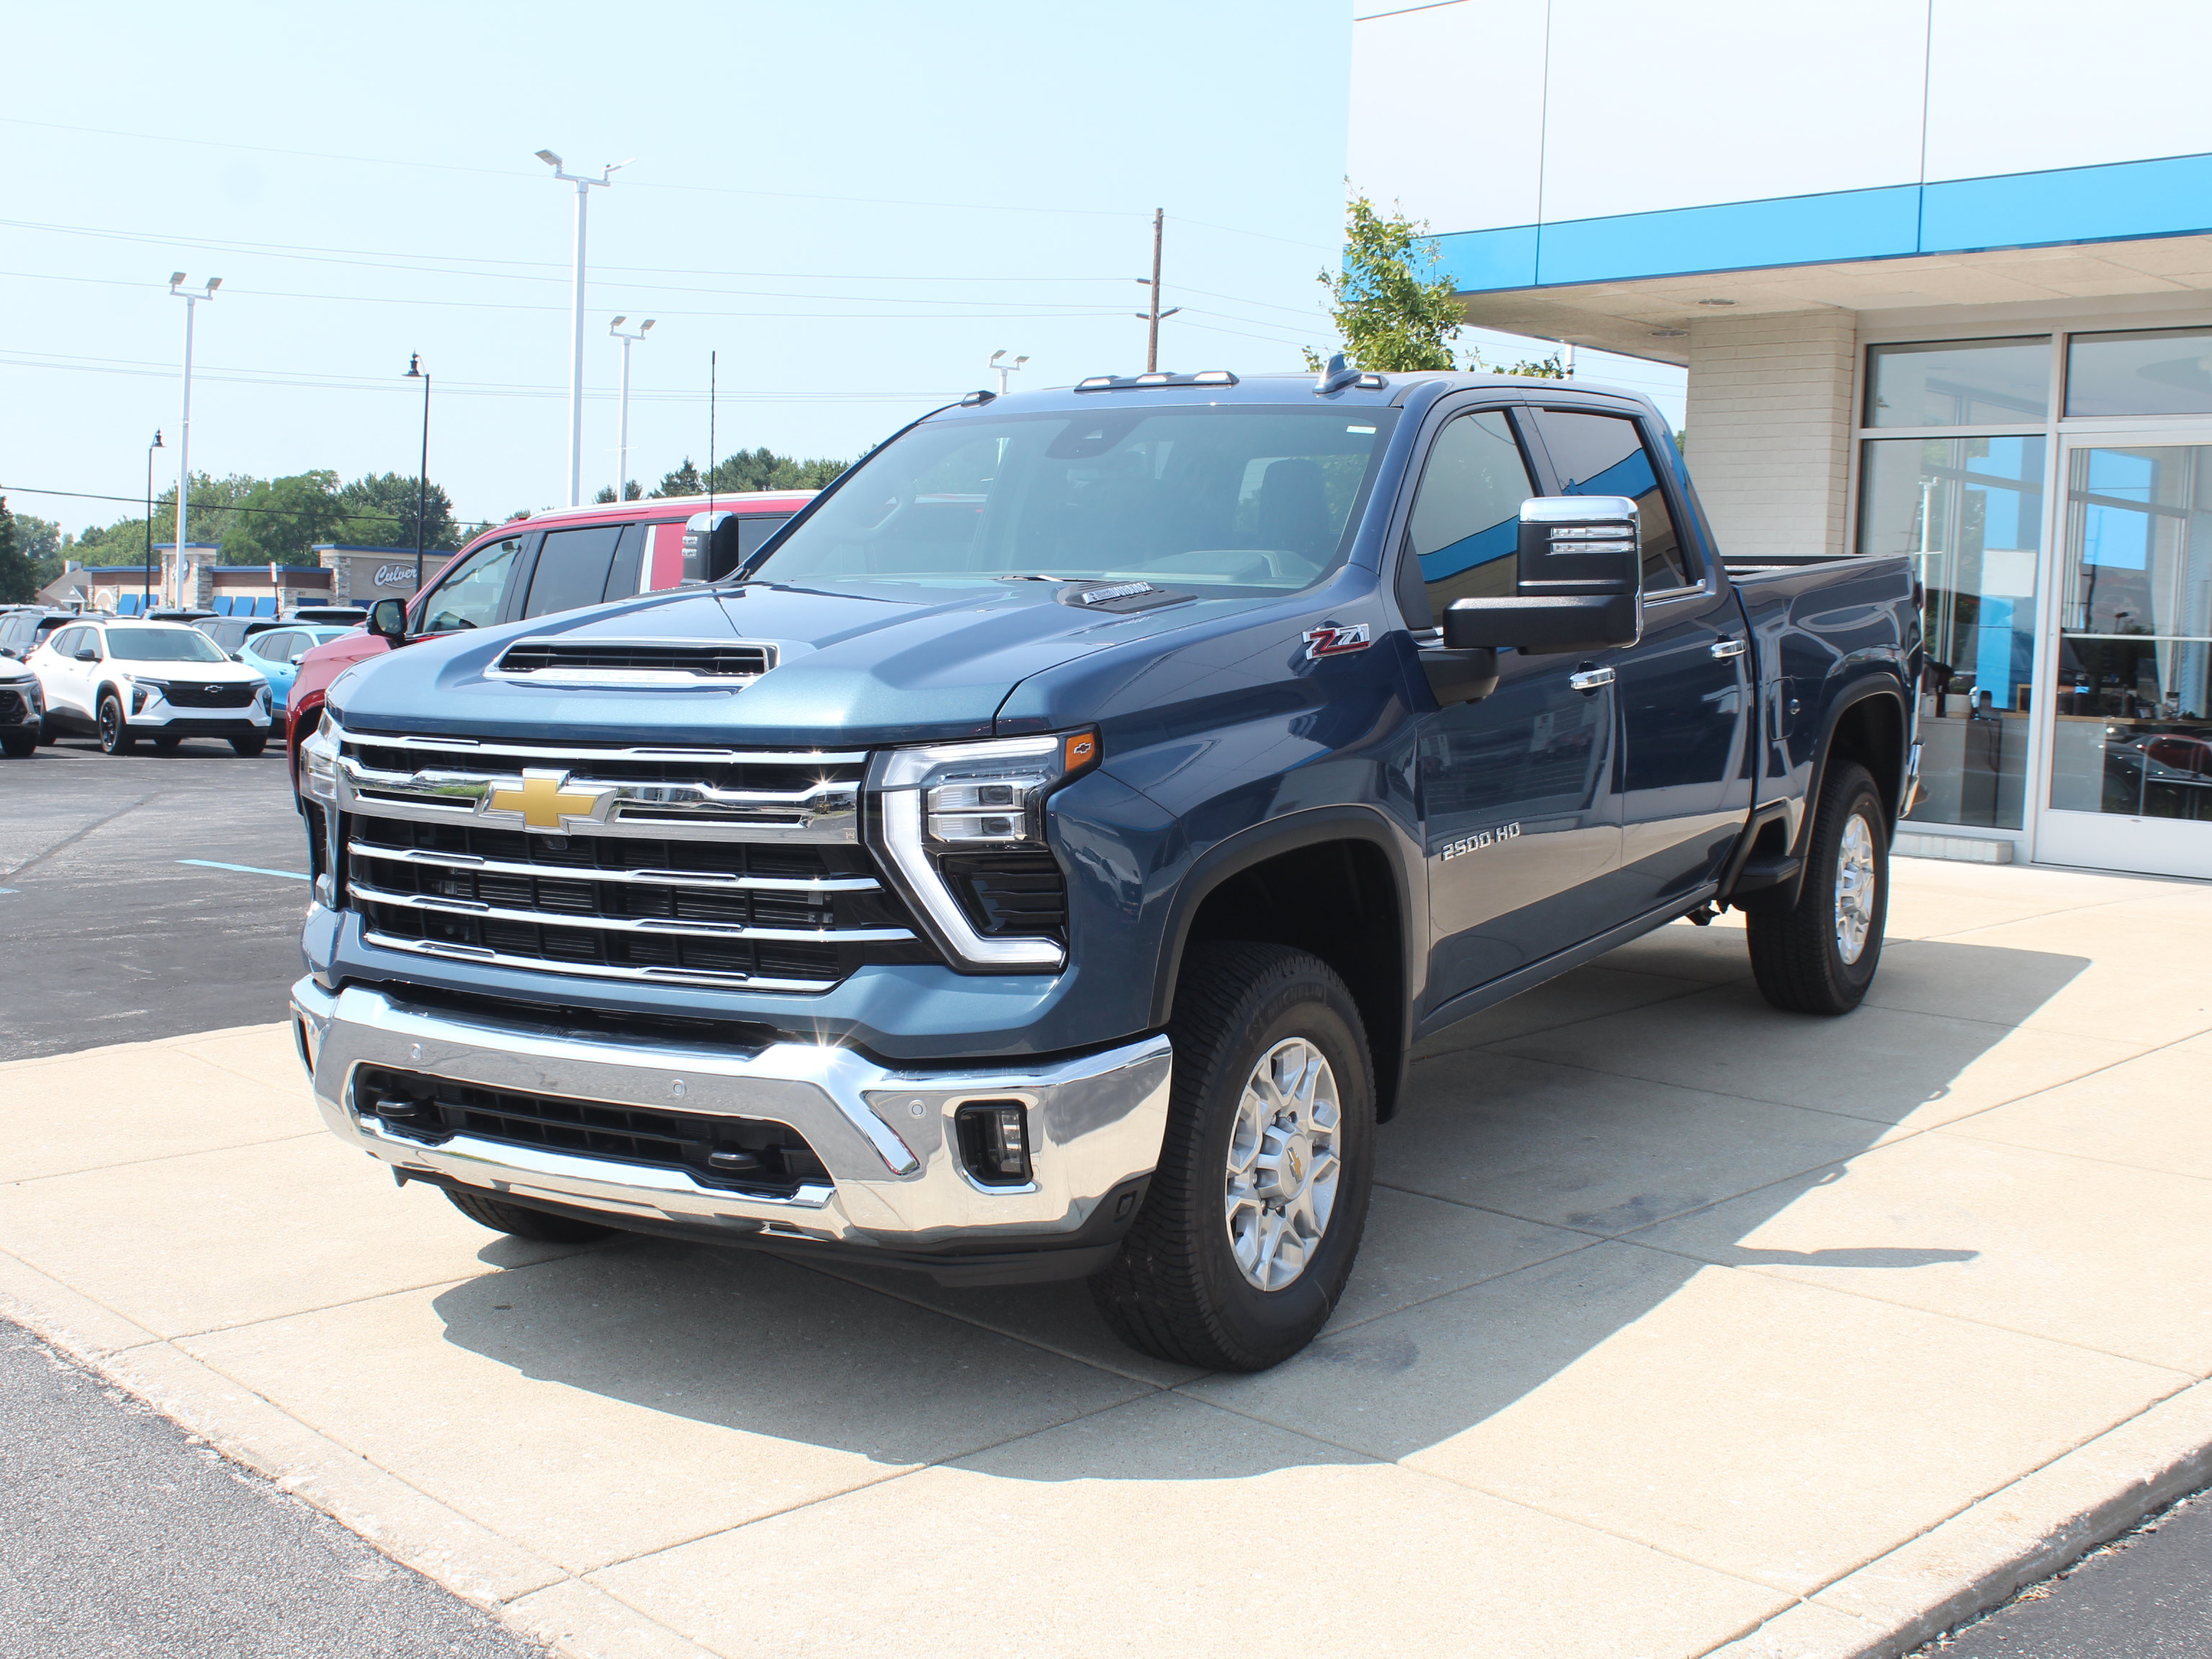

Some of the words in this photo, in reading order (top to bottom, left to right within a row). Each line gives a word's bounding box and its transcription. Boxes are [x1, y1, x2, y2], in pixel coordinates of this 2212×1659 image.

[374, 565, 418, 586] Culver
[1303, 624, 1370, 660] Z71
[1442, 831, 1491, 861] 2500
[1495, 822, 1520, 842] HD
